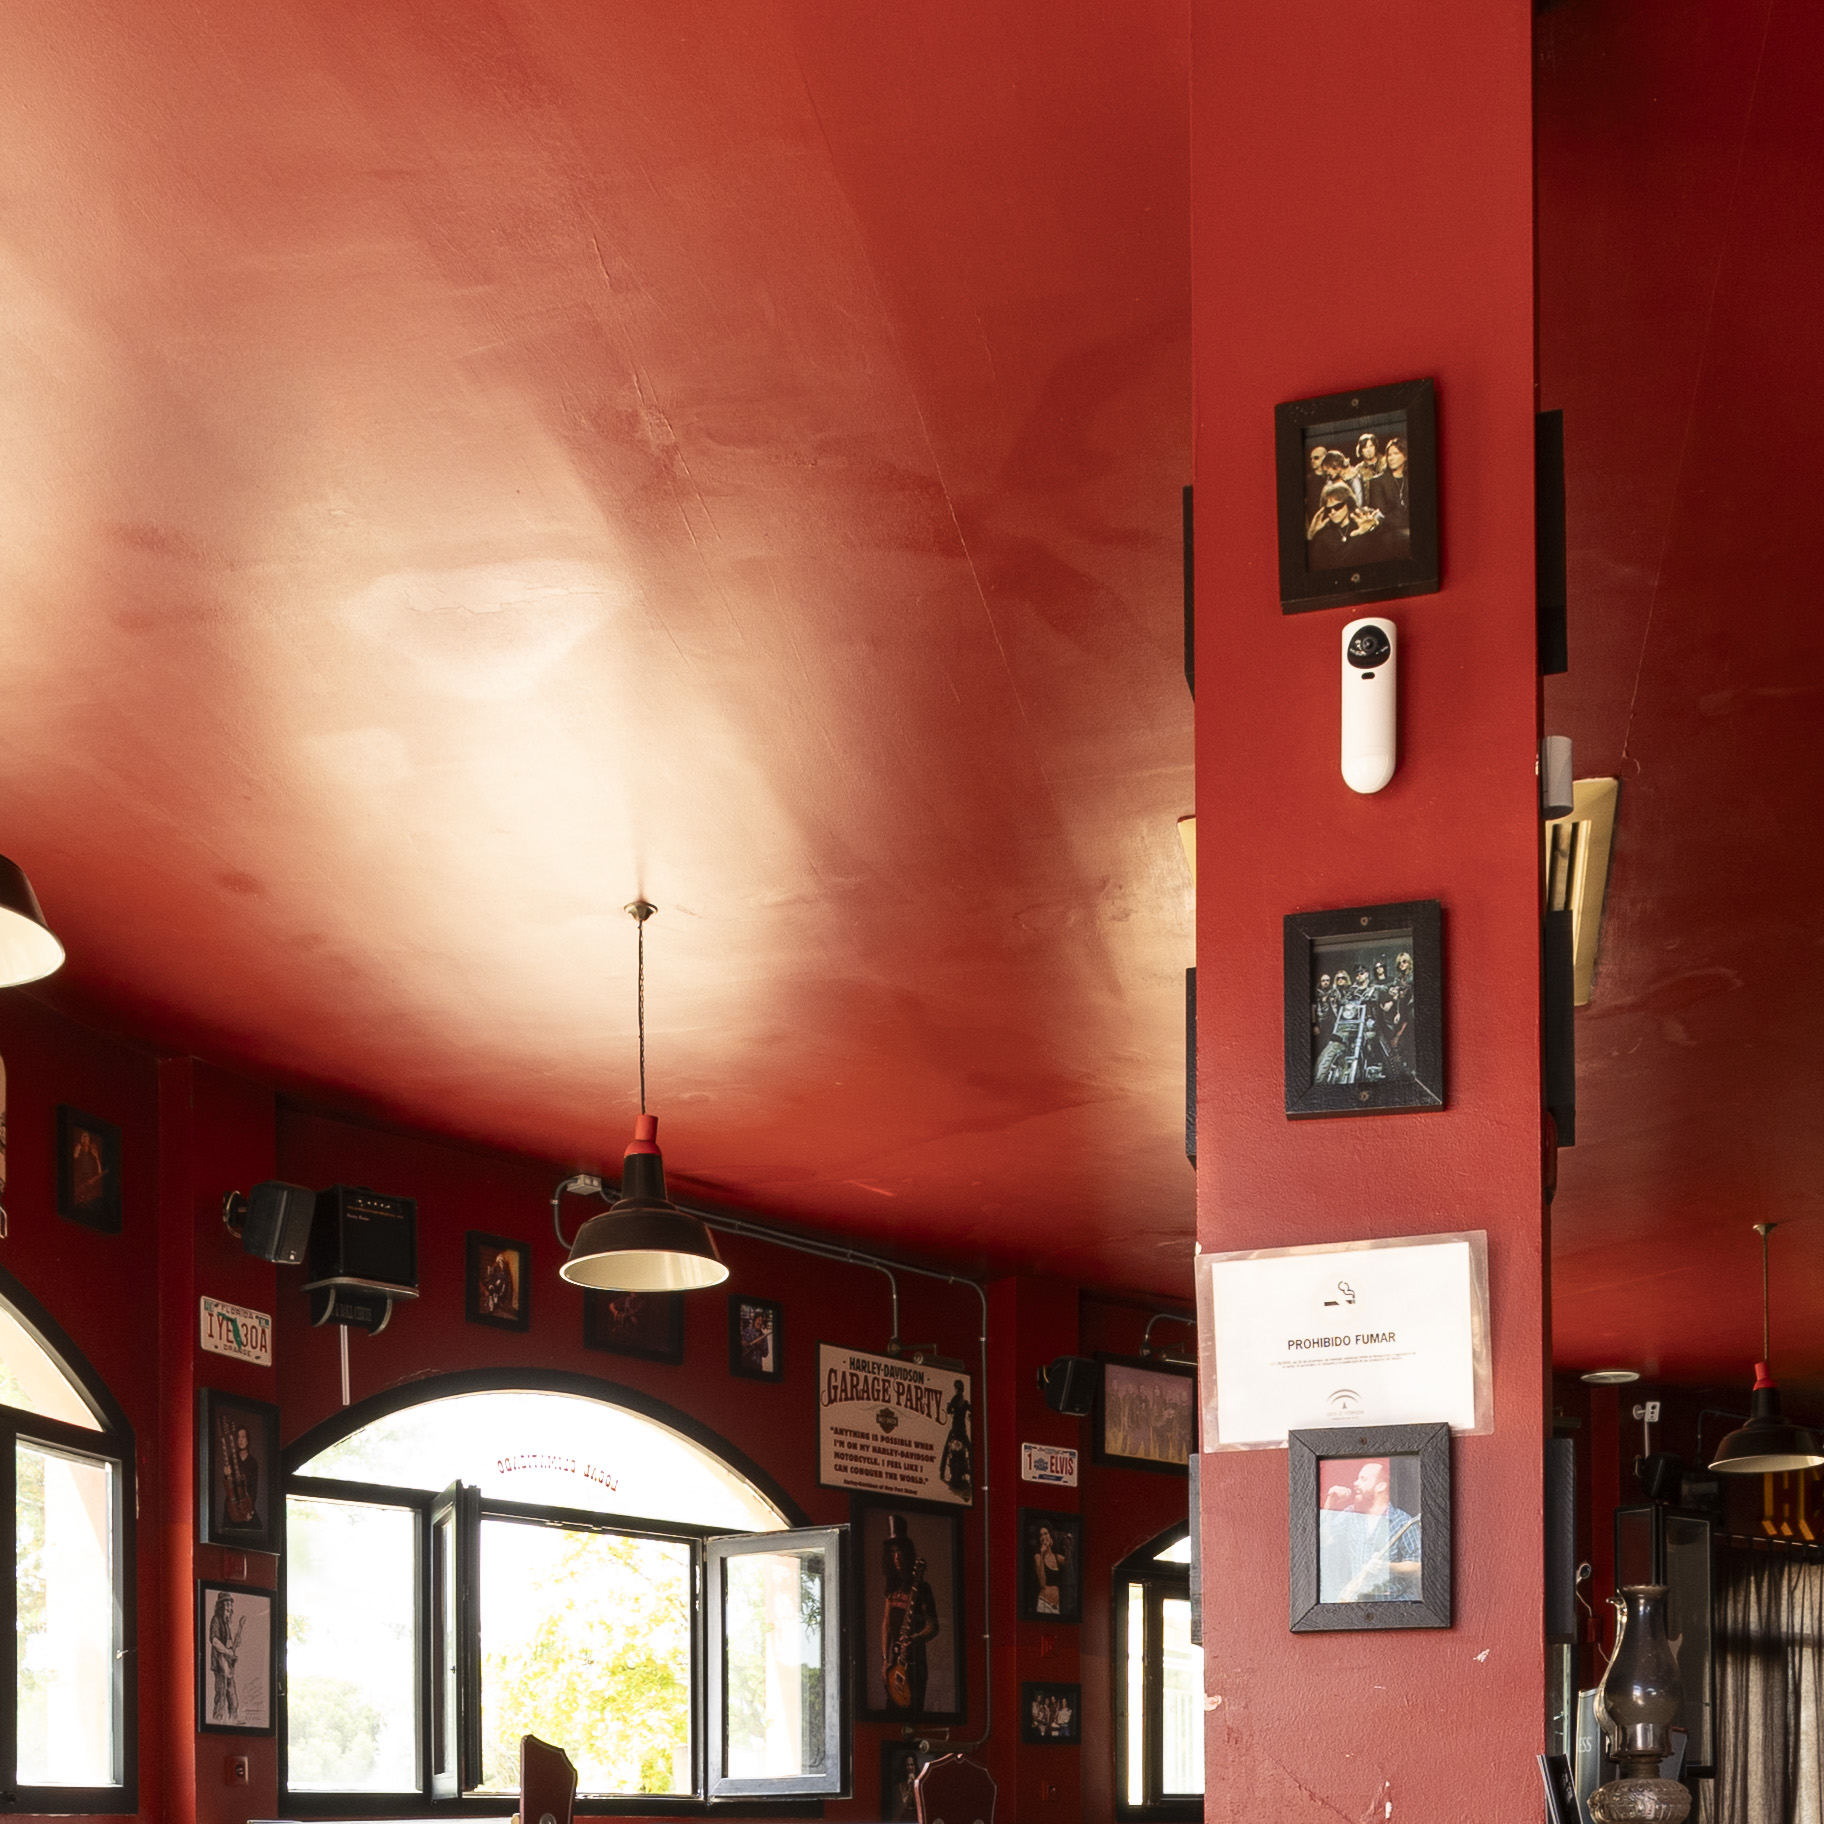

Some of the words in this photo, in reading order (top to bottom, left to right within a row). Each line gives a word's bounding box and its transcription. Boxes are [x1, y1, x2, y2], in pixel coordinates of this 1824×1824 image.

[222, 1304, 253, 1319] FLORIDA
[1287, 1335, 1351, 1351] PROHIBIDO
[1355, 1331, 1396, 1346] FUMAR
[224, 1344, 251, 1357] ORANGE
[849, 1357, 924, 1384] HARLEY-DAVIDSON
[820, 1367, 891, 1407] GARAGE
[893, 1379, 947, 1426] PARTY
[847, 1442, 858, 1450] ON
[860, 1443, 870, 1452] MY
[872, 1433, 879, 1441] IS
[880, 1435, 912, 1448] POSSIBLE
[914, 1441, 934, 1451] WHEN
[834, 1464, 848, 1473] CAN
[850, 1466, 884, 1479] CONQUER
[885, 1472, 898, 1480] THE
[887, 1460, 902, 1471] FEEL
[904, 1463, 918, 1472] LIKE
[920, 1465, 923, 1473] I
[1027, 1453, 1032, 1470] 1
[1050, 1455, 1074, 1475] ELVIS
